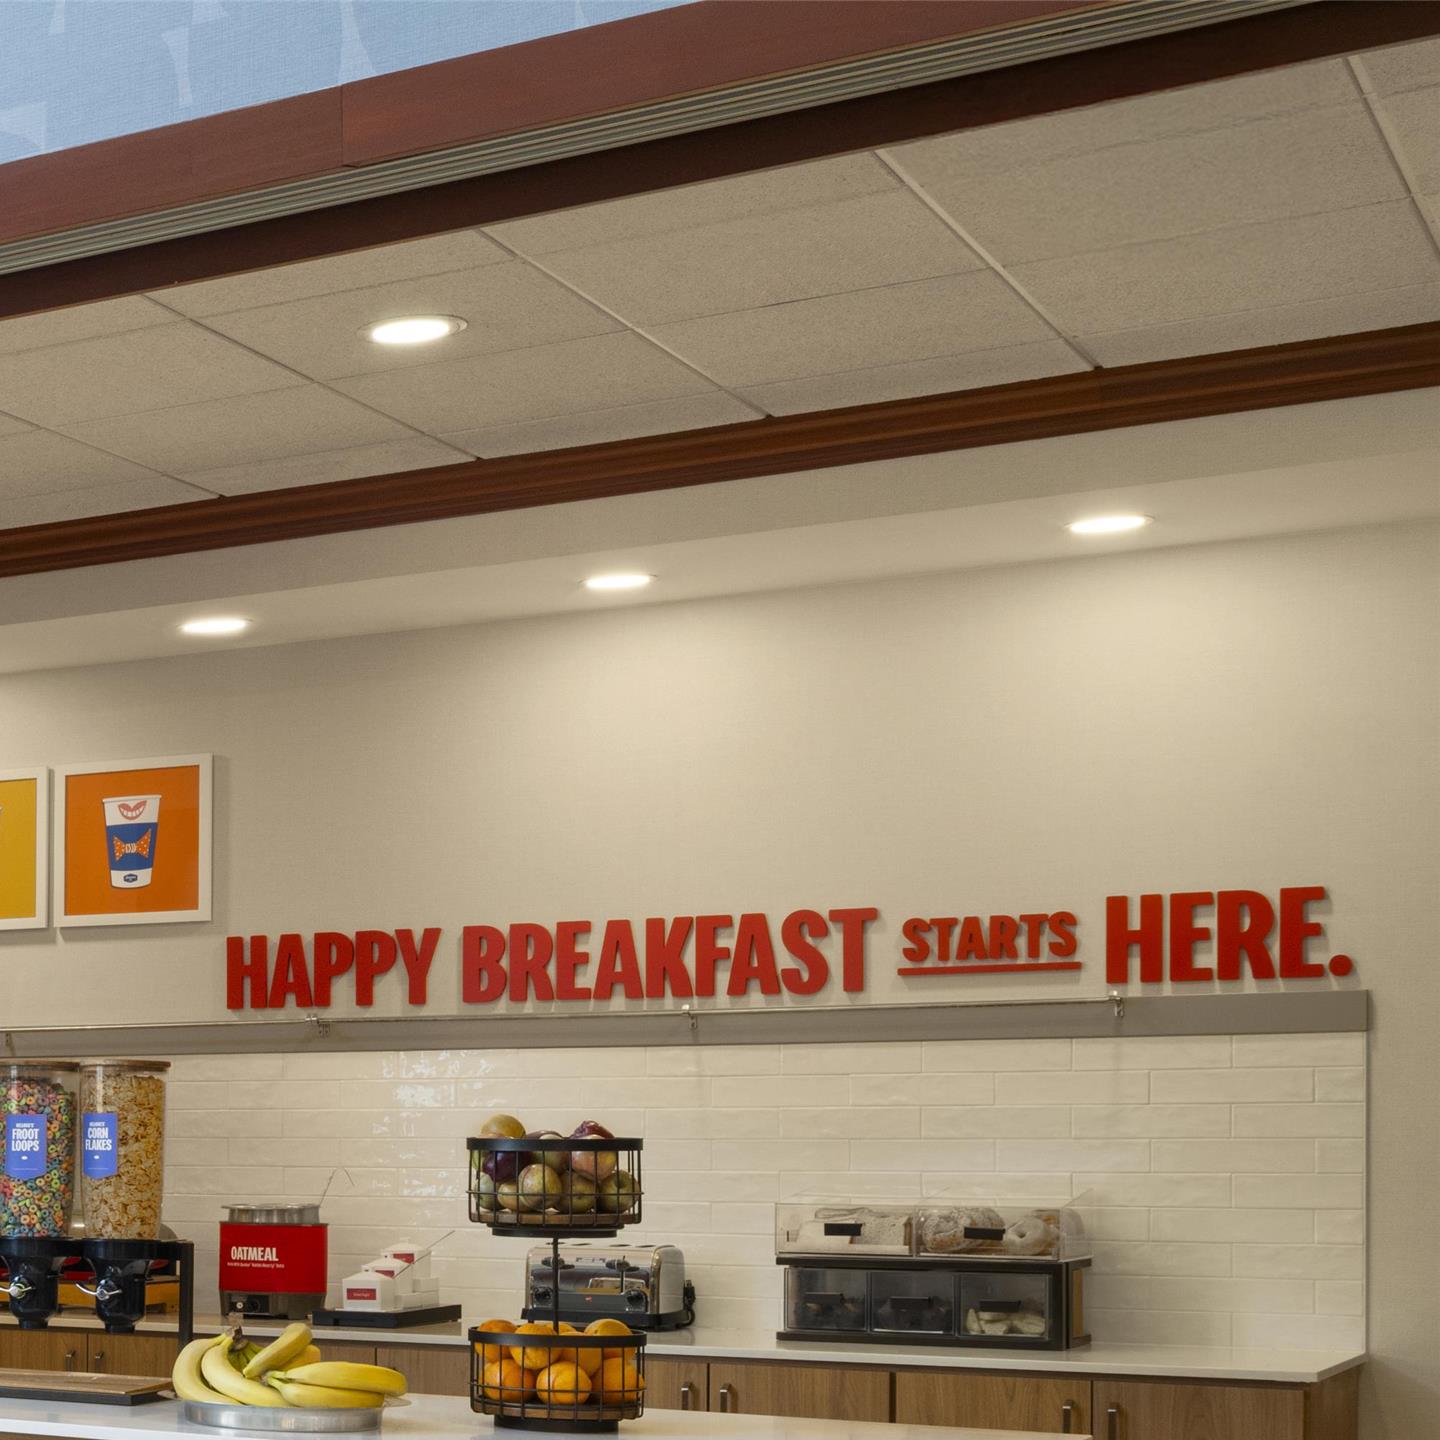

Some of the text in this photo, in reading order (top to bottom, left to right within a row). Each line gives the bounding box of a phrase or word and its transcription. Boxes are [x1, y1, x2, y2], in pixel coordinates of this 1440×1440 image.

[227, 886, 1353, 1009] HAPPY BREAKFAST STARTS HERE.
[12, 1128, 39, 1140] FROOT
[87, 1127, 109, 1139] CORN
[12, 1139, 40, 1152] LOOPS
[85, 1138, 112, 1151] FLAKES
[231, 1246, 280, 1261] OATMEAL
